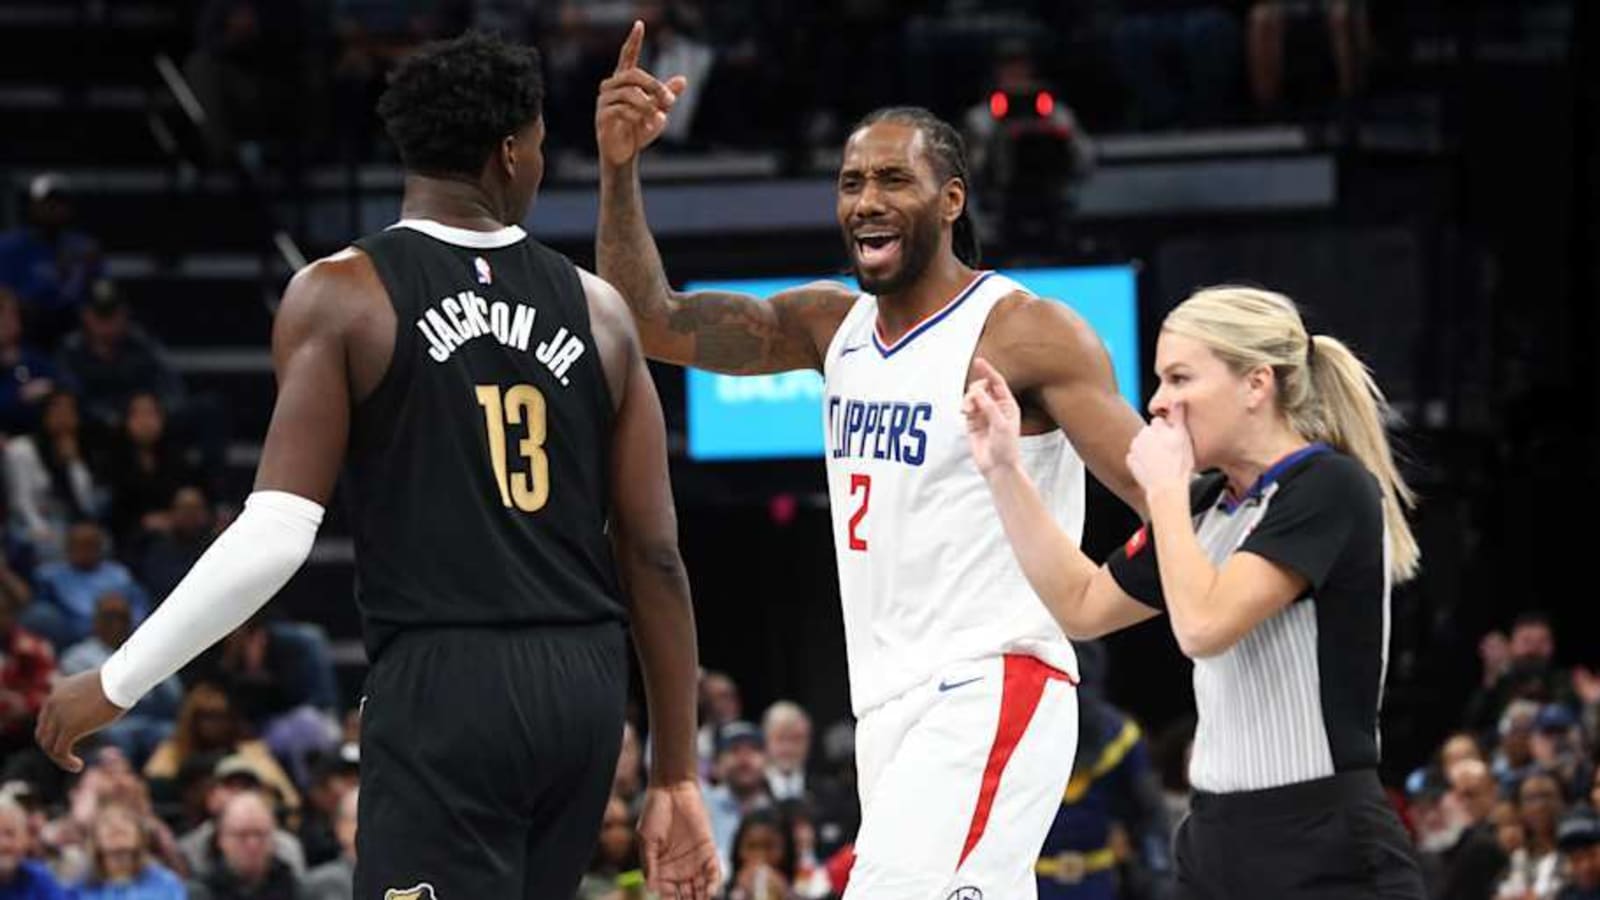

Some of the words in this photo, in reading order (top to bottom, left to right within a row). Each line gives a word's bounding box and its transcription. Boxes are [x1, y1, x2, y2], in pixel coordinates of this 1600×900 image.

[535, 327, 585, 387] JR.
[475, 383, 549, 513] 13
[829, 394, 932, 467] CLIPPERS
[848, 473, 871, 552] 2
